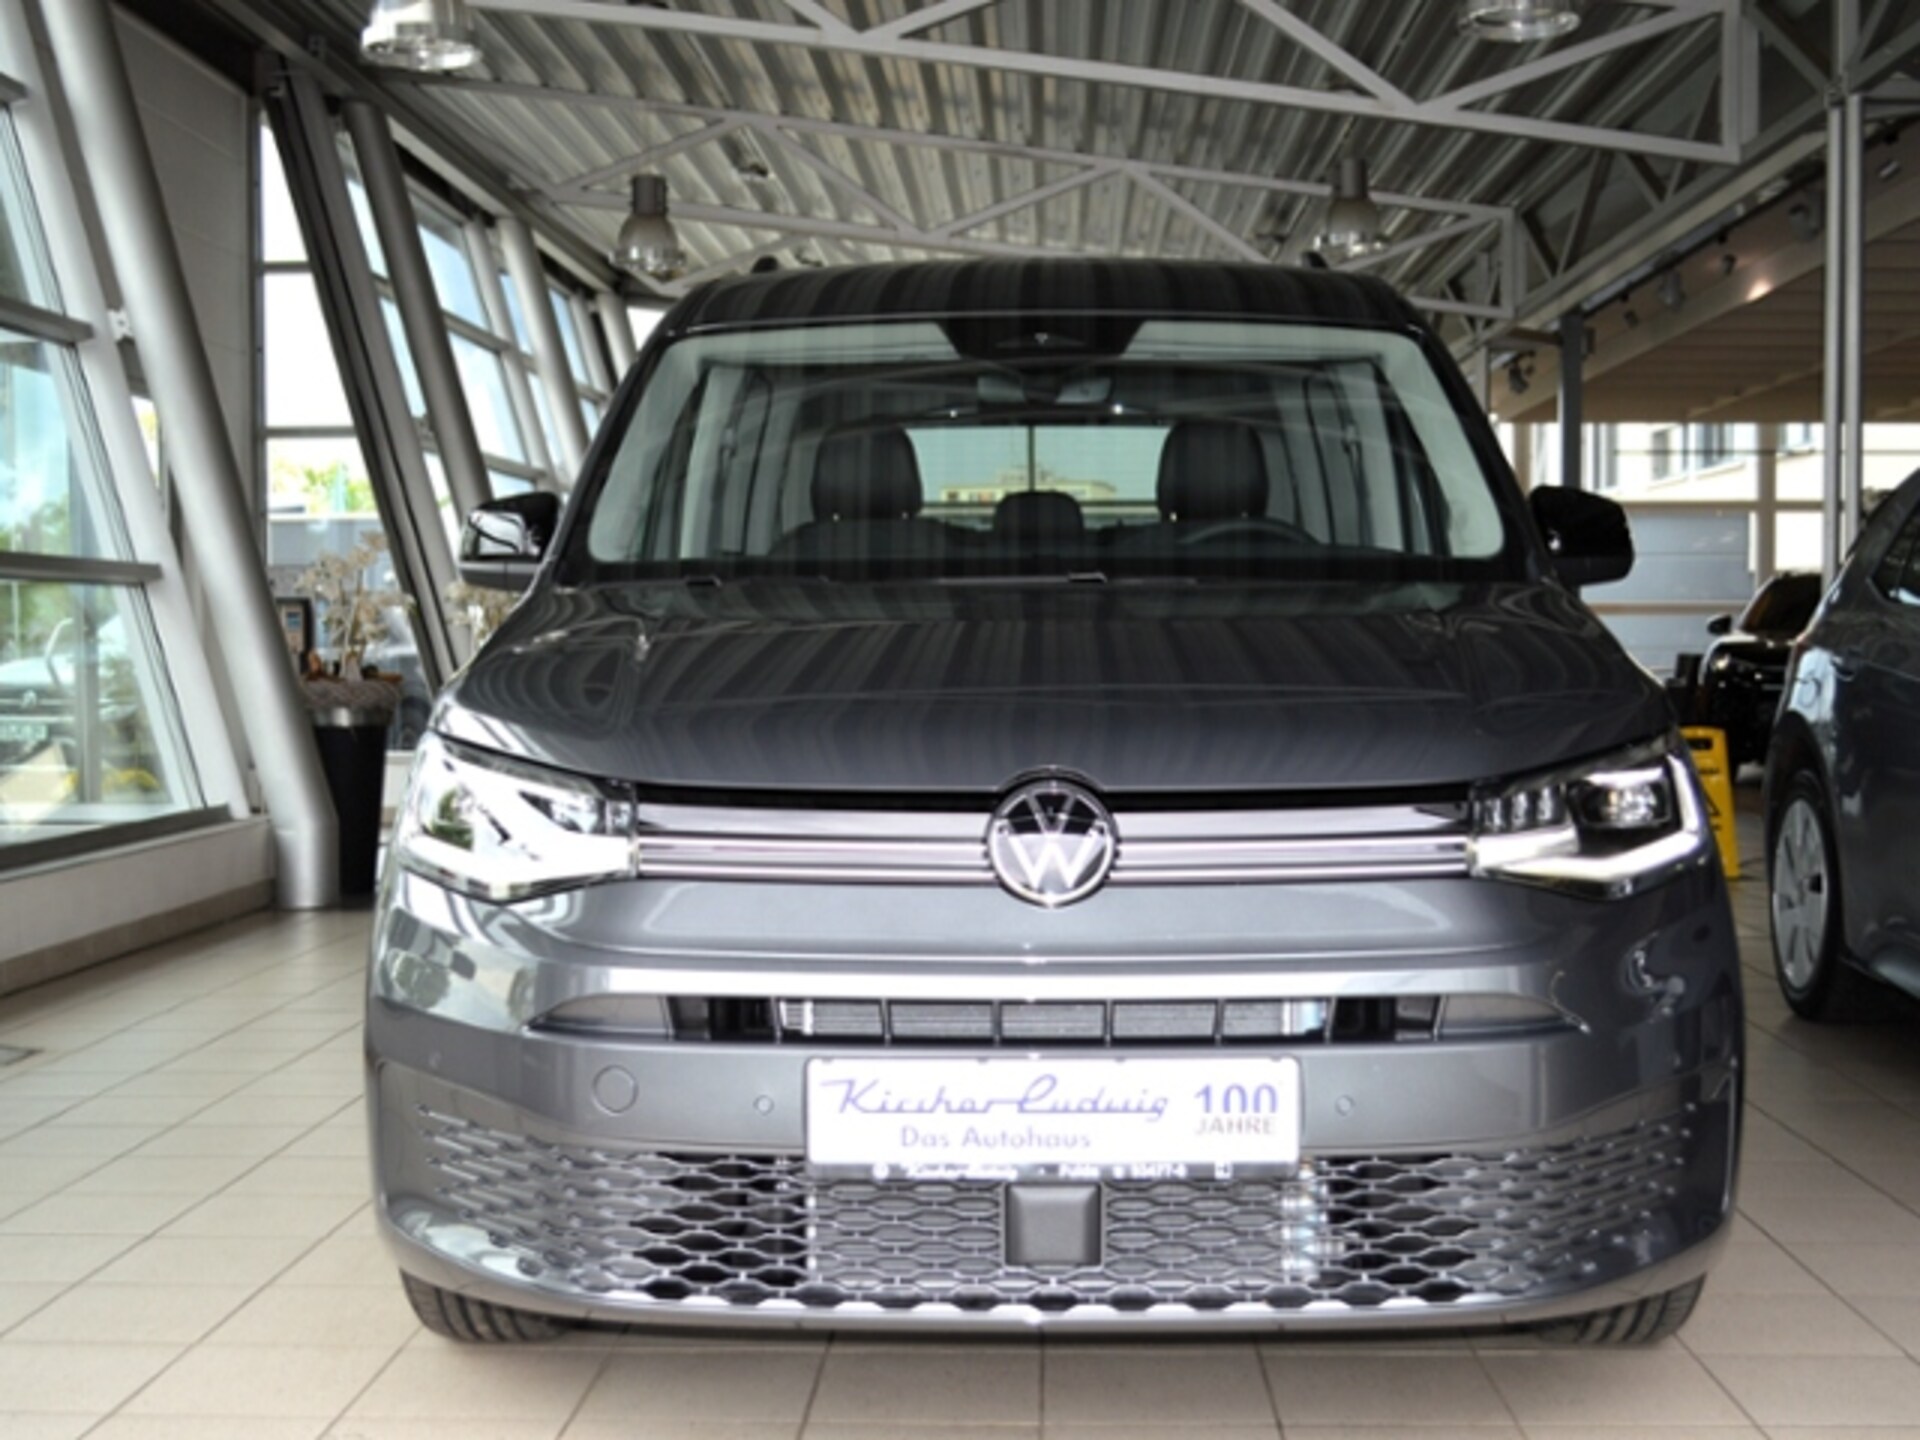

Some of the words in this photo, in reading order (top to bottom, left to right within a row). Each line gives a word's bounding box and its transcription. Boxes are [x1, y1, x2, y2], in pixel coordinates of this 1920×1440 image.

[1017, 1073, 1169, 1122] Ludwig
[1195, 1083, 1278, 1114] 100
[901, 1125, 951, 1148] Das
[961, 1125, 1091, 1148] Autohaus
[1195, 1116, 1275, 1135] JAHRE
